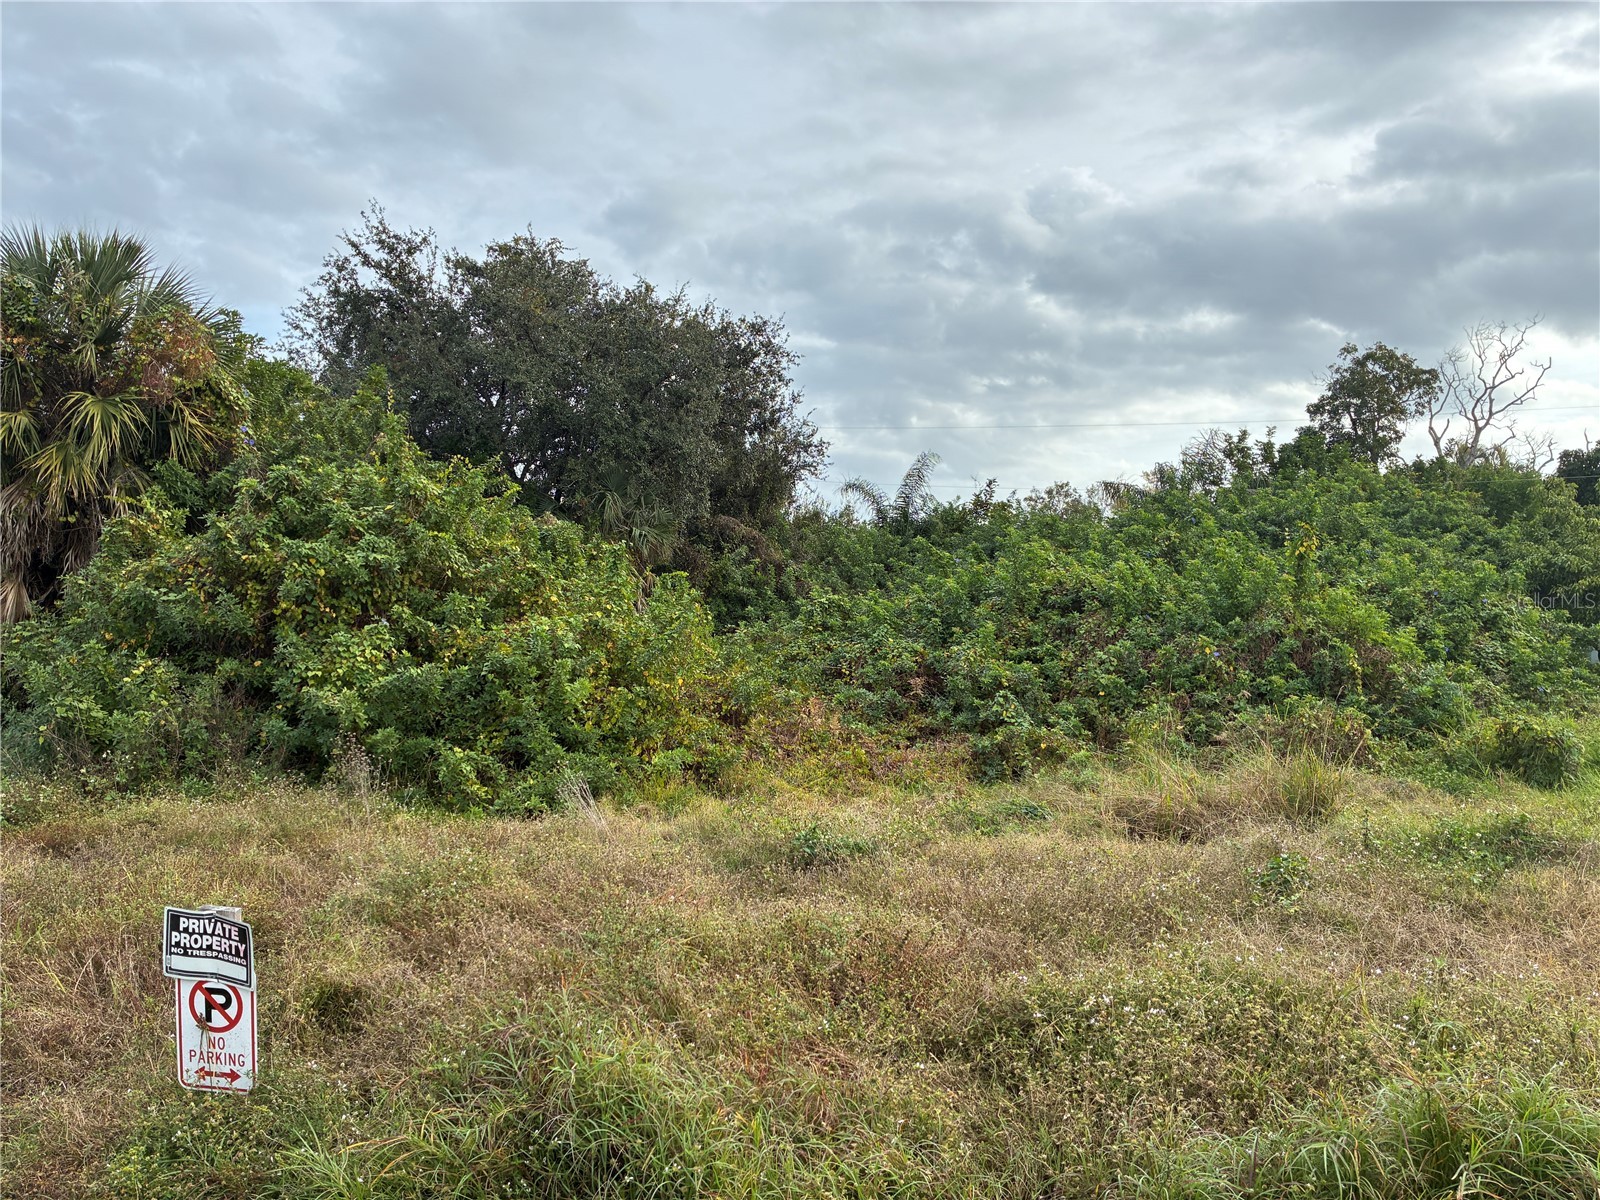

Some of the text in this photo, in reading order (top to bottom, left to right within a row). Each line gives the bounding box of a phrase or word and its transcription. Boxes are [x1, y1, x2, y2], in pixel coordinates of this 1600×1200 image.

[179, 917, 240, 941] PRIVATE
[171, 931, 246, 957] PROPERTY
[171, 946, 247, 966] NO TRESPASSING
[204, 987, 233, 1023] P
[208, 1036, 226, 1051] NO
[189, 1049, 246, 1068] PARKING
